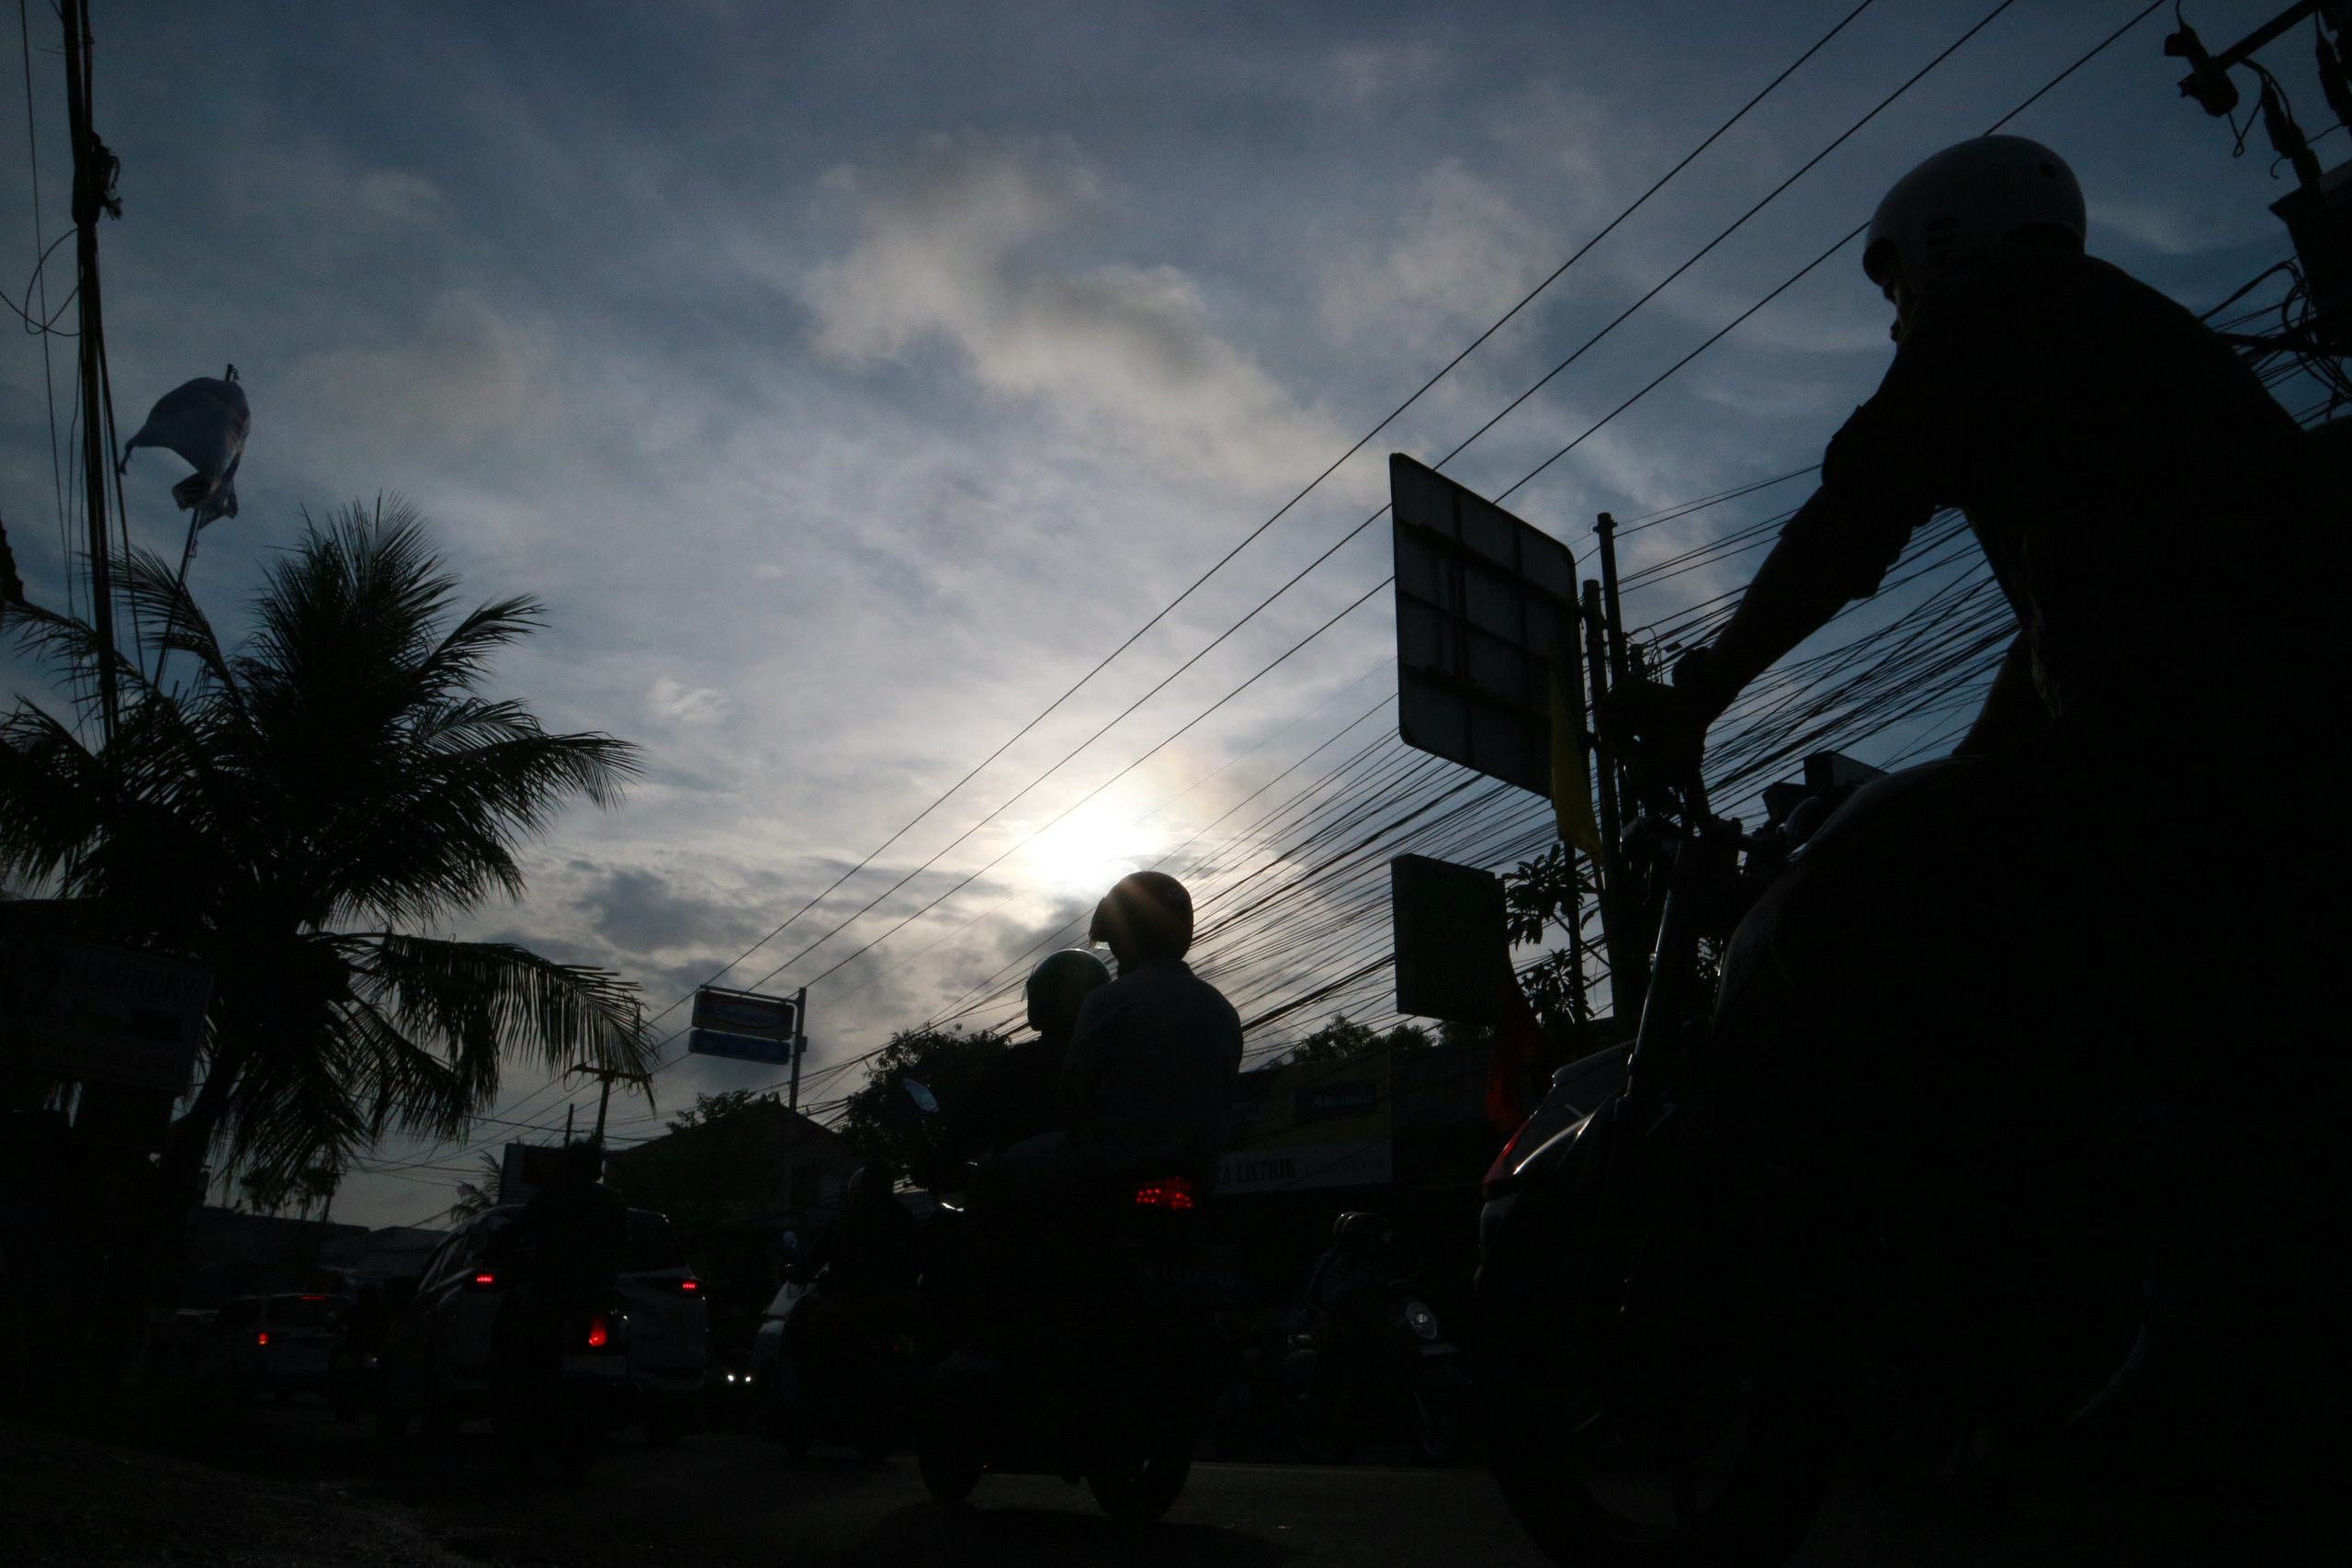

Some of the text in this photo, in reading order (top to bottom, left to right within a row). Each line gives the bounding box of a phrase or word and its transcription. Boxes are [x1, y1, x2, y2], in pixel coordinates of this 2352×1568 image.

[79, 955, 201, 1009] LAUNDRY
[715, 1004, 776, 1023] Indomaret
[99, 1048, 183, 1077] SELESAI
[1311, 1093, 1373, 1109] Alkaline
[1237, 1157, 1296, 1182] LISTRIK
